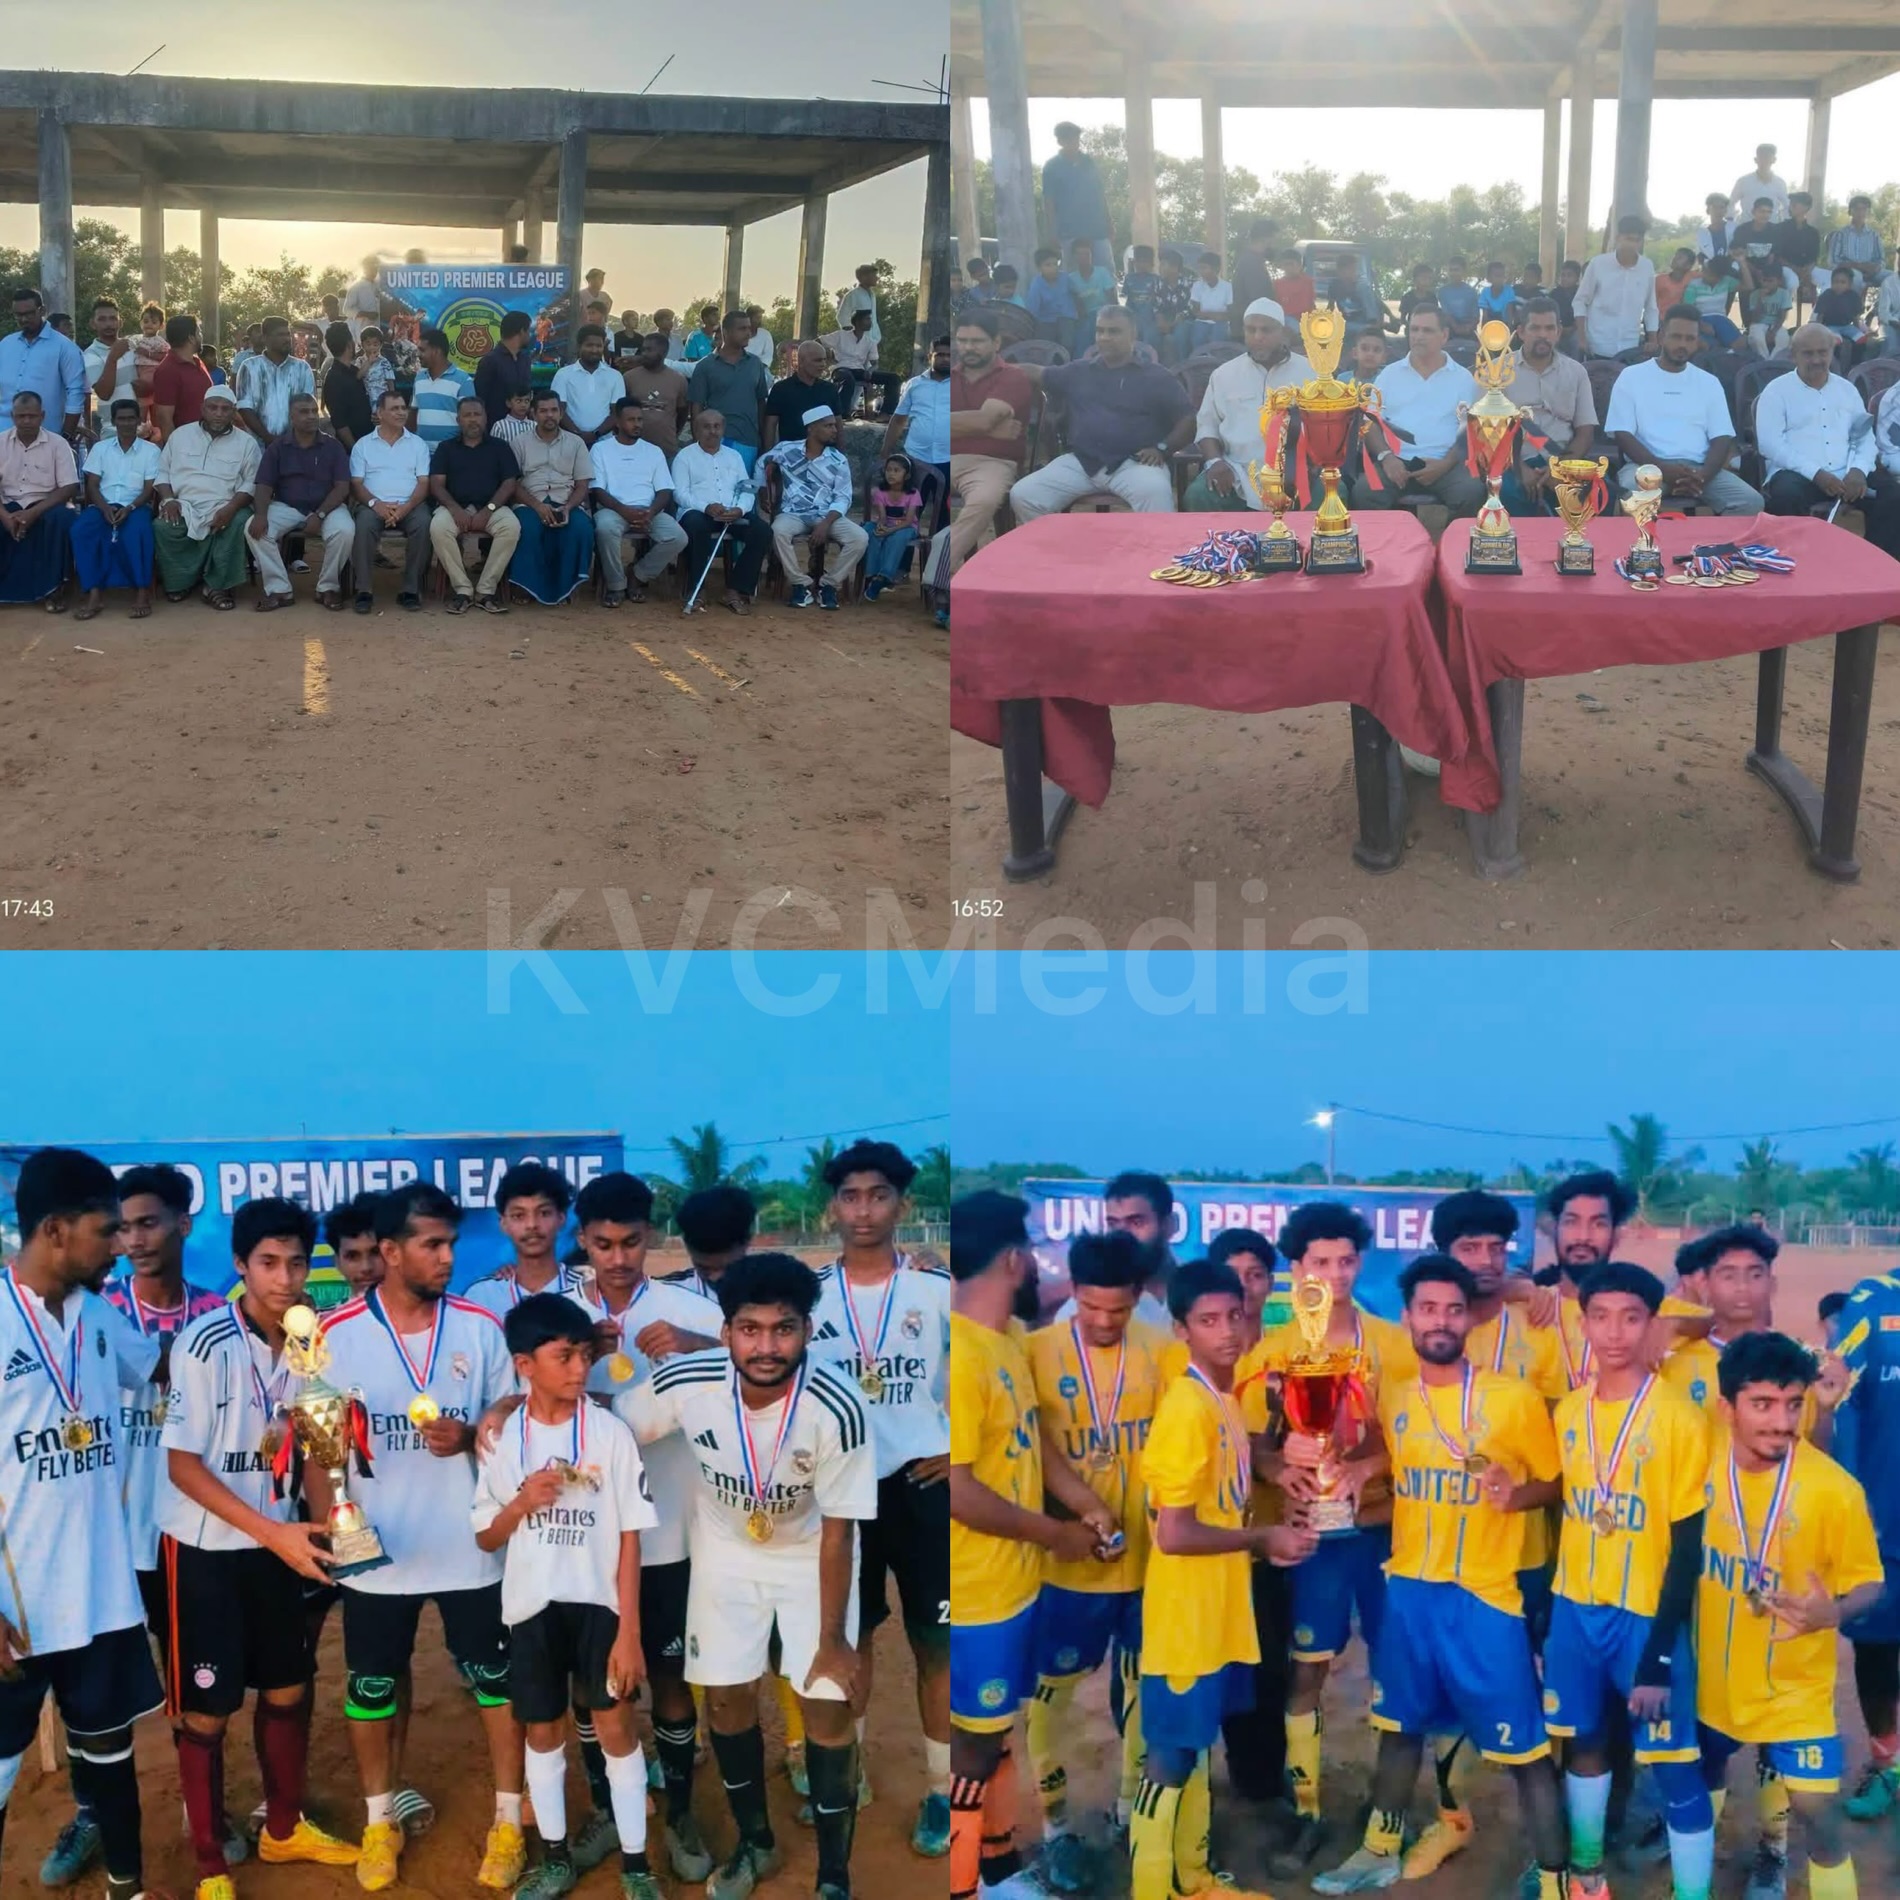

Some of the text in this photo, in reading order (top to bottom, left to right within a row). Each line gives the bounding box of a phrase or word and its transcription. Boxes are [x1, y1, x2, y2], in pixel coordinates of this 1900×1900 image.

[387, 271, 564, 288] UNITED PREMIER LEAGUE
[4, 1362, 42, 1381] adidas
[387, 1433, 408, 1451] FLY
[38, 1451, 69, 1482] FLY
[717, 1490, 738, 1508] FLY
[547, 1528, 586, 1547] BETTER
[1496, 1721, 1514, 1746] 2
